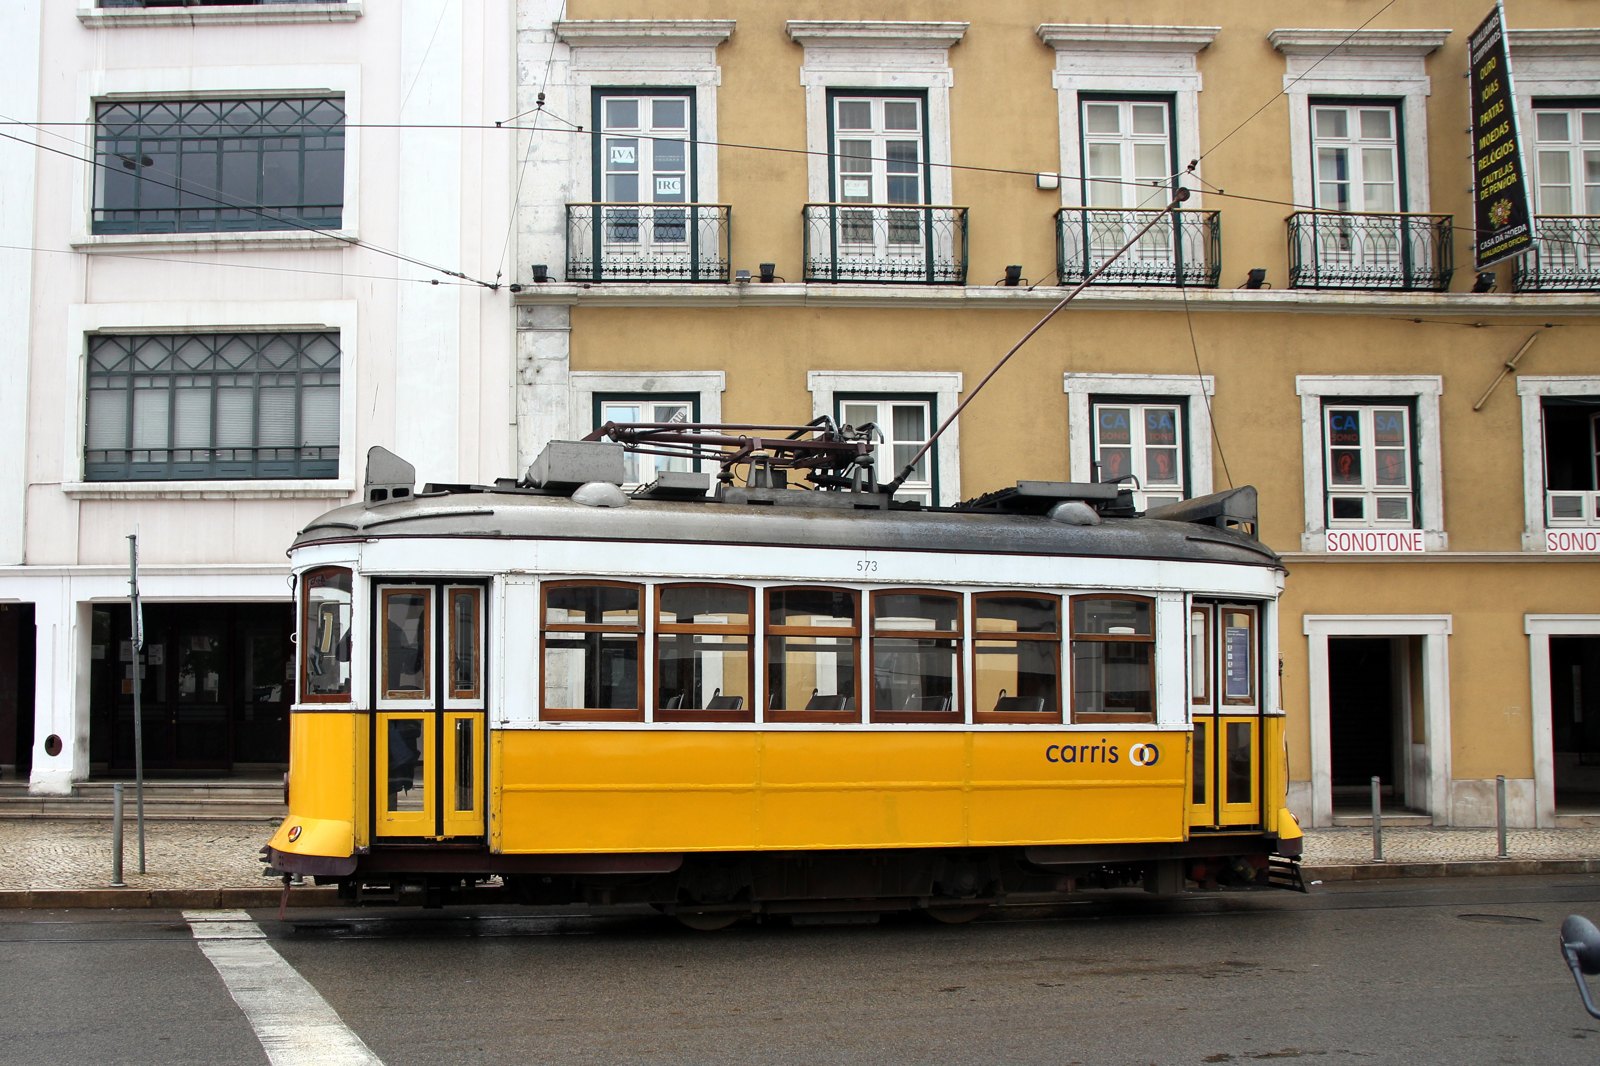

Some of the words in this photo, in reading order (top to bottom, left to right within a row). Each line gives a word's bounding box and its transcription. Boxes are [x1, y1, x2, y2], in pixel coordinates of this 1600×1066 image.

[1472, 28, 1501, 65] COMPRAMOS
[1480, 56, 1496, 80] OURO
[1480, 100, 1504, 127] PRATAS
[1479, 120, 1509, 150] MOEDAS
[612, 149, 633, 159] IVA
[1478, 139, 1514, 172] RELÓGIOS
[658, 180, 680, 190] IRC
[1480, 188, 1489, 200] DE
[1489, 173, 1517, 195] PENHOR
[1482, 162, 1514, 187] CAUTELAS
[1480, 238, 1495, 250] CASA
[1495, 234, 1504, 244] DA
[1504, 223, 1527, 240] MOEDA
[1480, 242, 1508, 260] AVALIADOR
[1508, 234, 1529, 248] OFICIAL
[1328, 532, 1423, 551] SONOTONE
[856, 560, 878, 572] 573
[1046, 738, 1119, 764] carris
